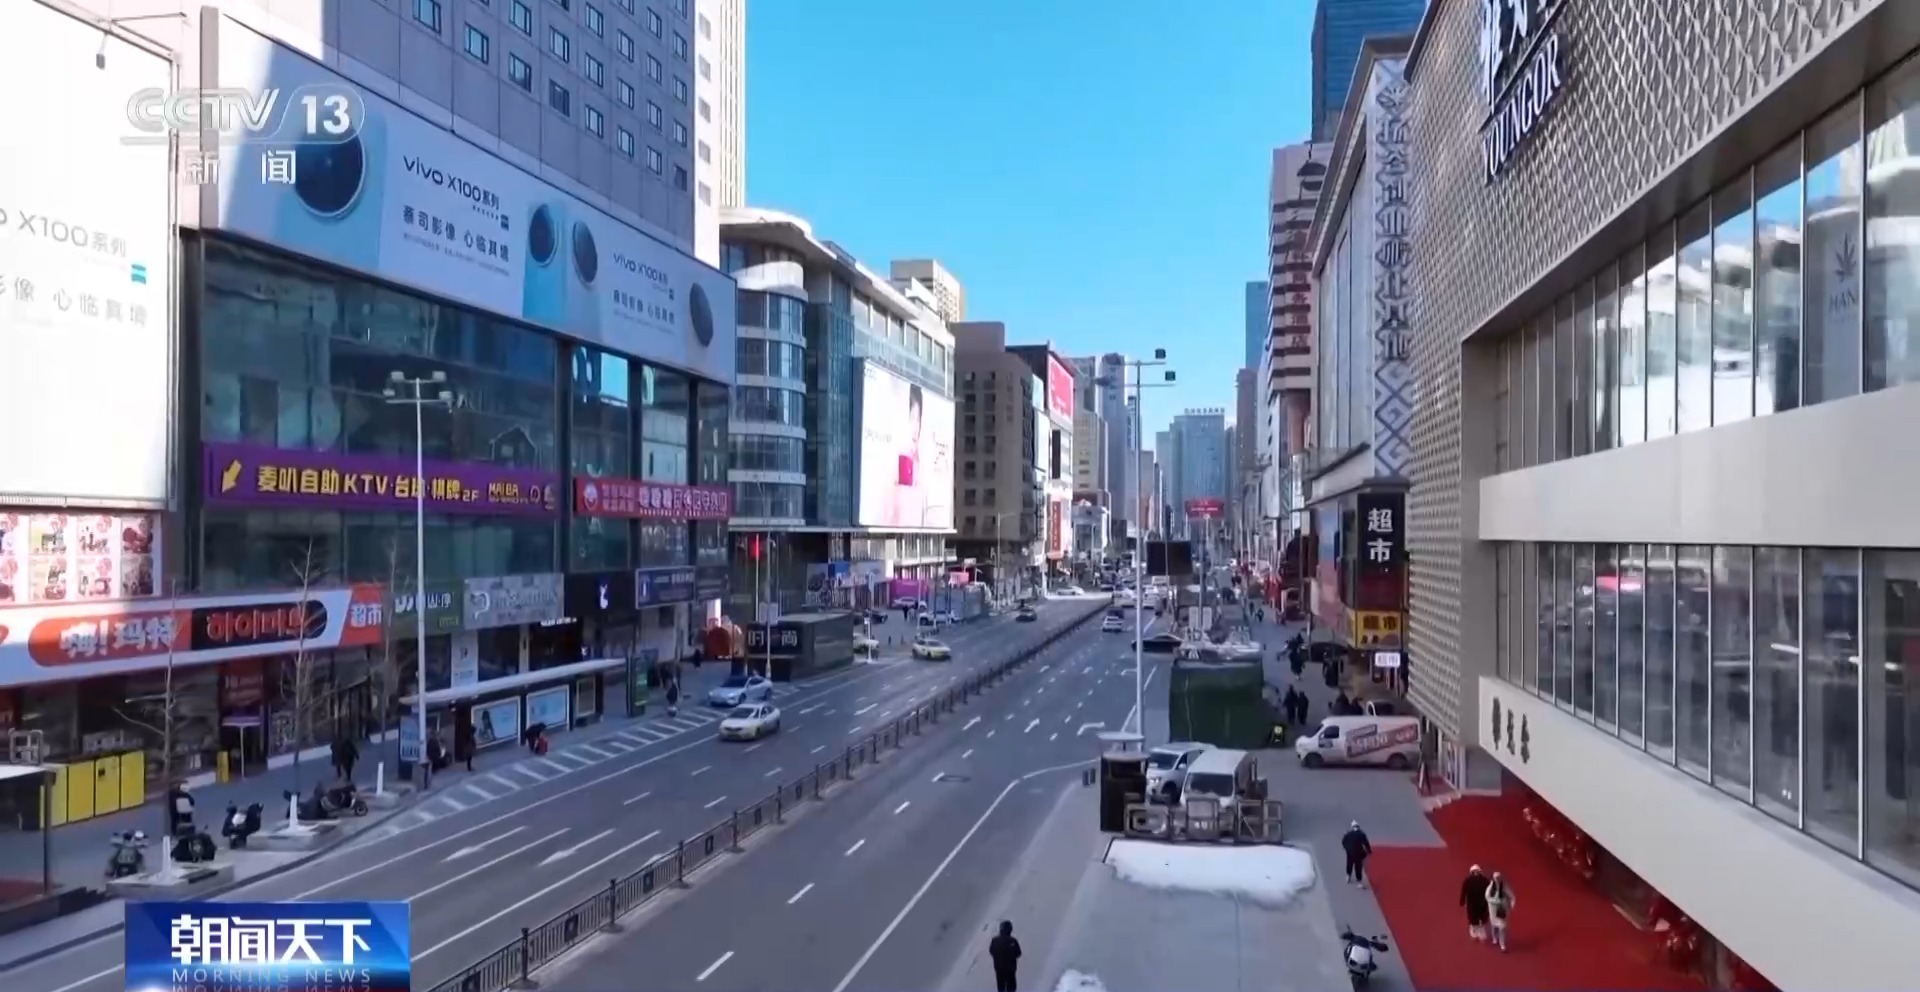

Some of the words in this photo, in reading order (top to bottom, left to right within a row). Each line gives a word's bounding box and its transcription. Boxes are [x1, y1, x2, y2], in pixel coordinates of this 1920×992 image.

[1483, 34, 1561, 187] YOUNGOR
[403, 155, 444, 185] vivo
[18, 210, 126, 258] X100系列
[613, 253, 637, 272] vivo
[1367, 508, 1394, 563] 超市
[351, 602, 382, 628] 超市
[747, 630, 798, 647] 时尚
